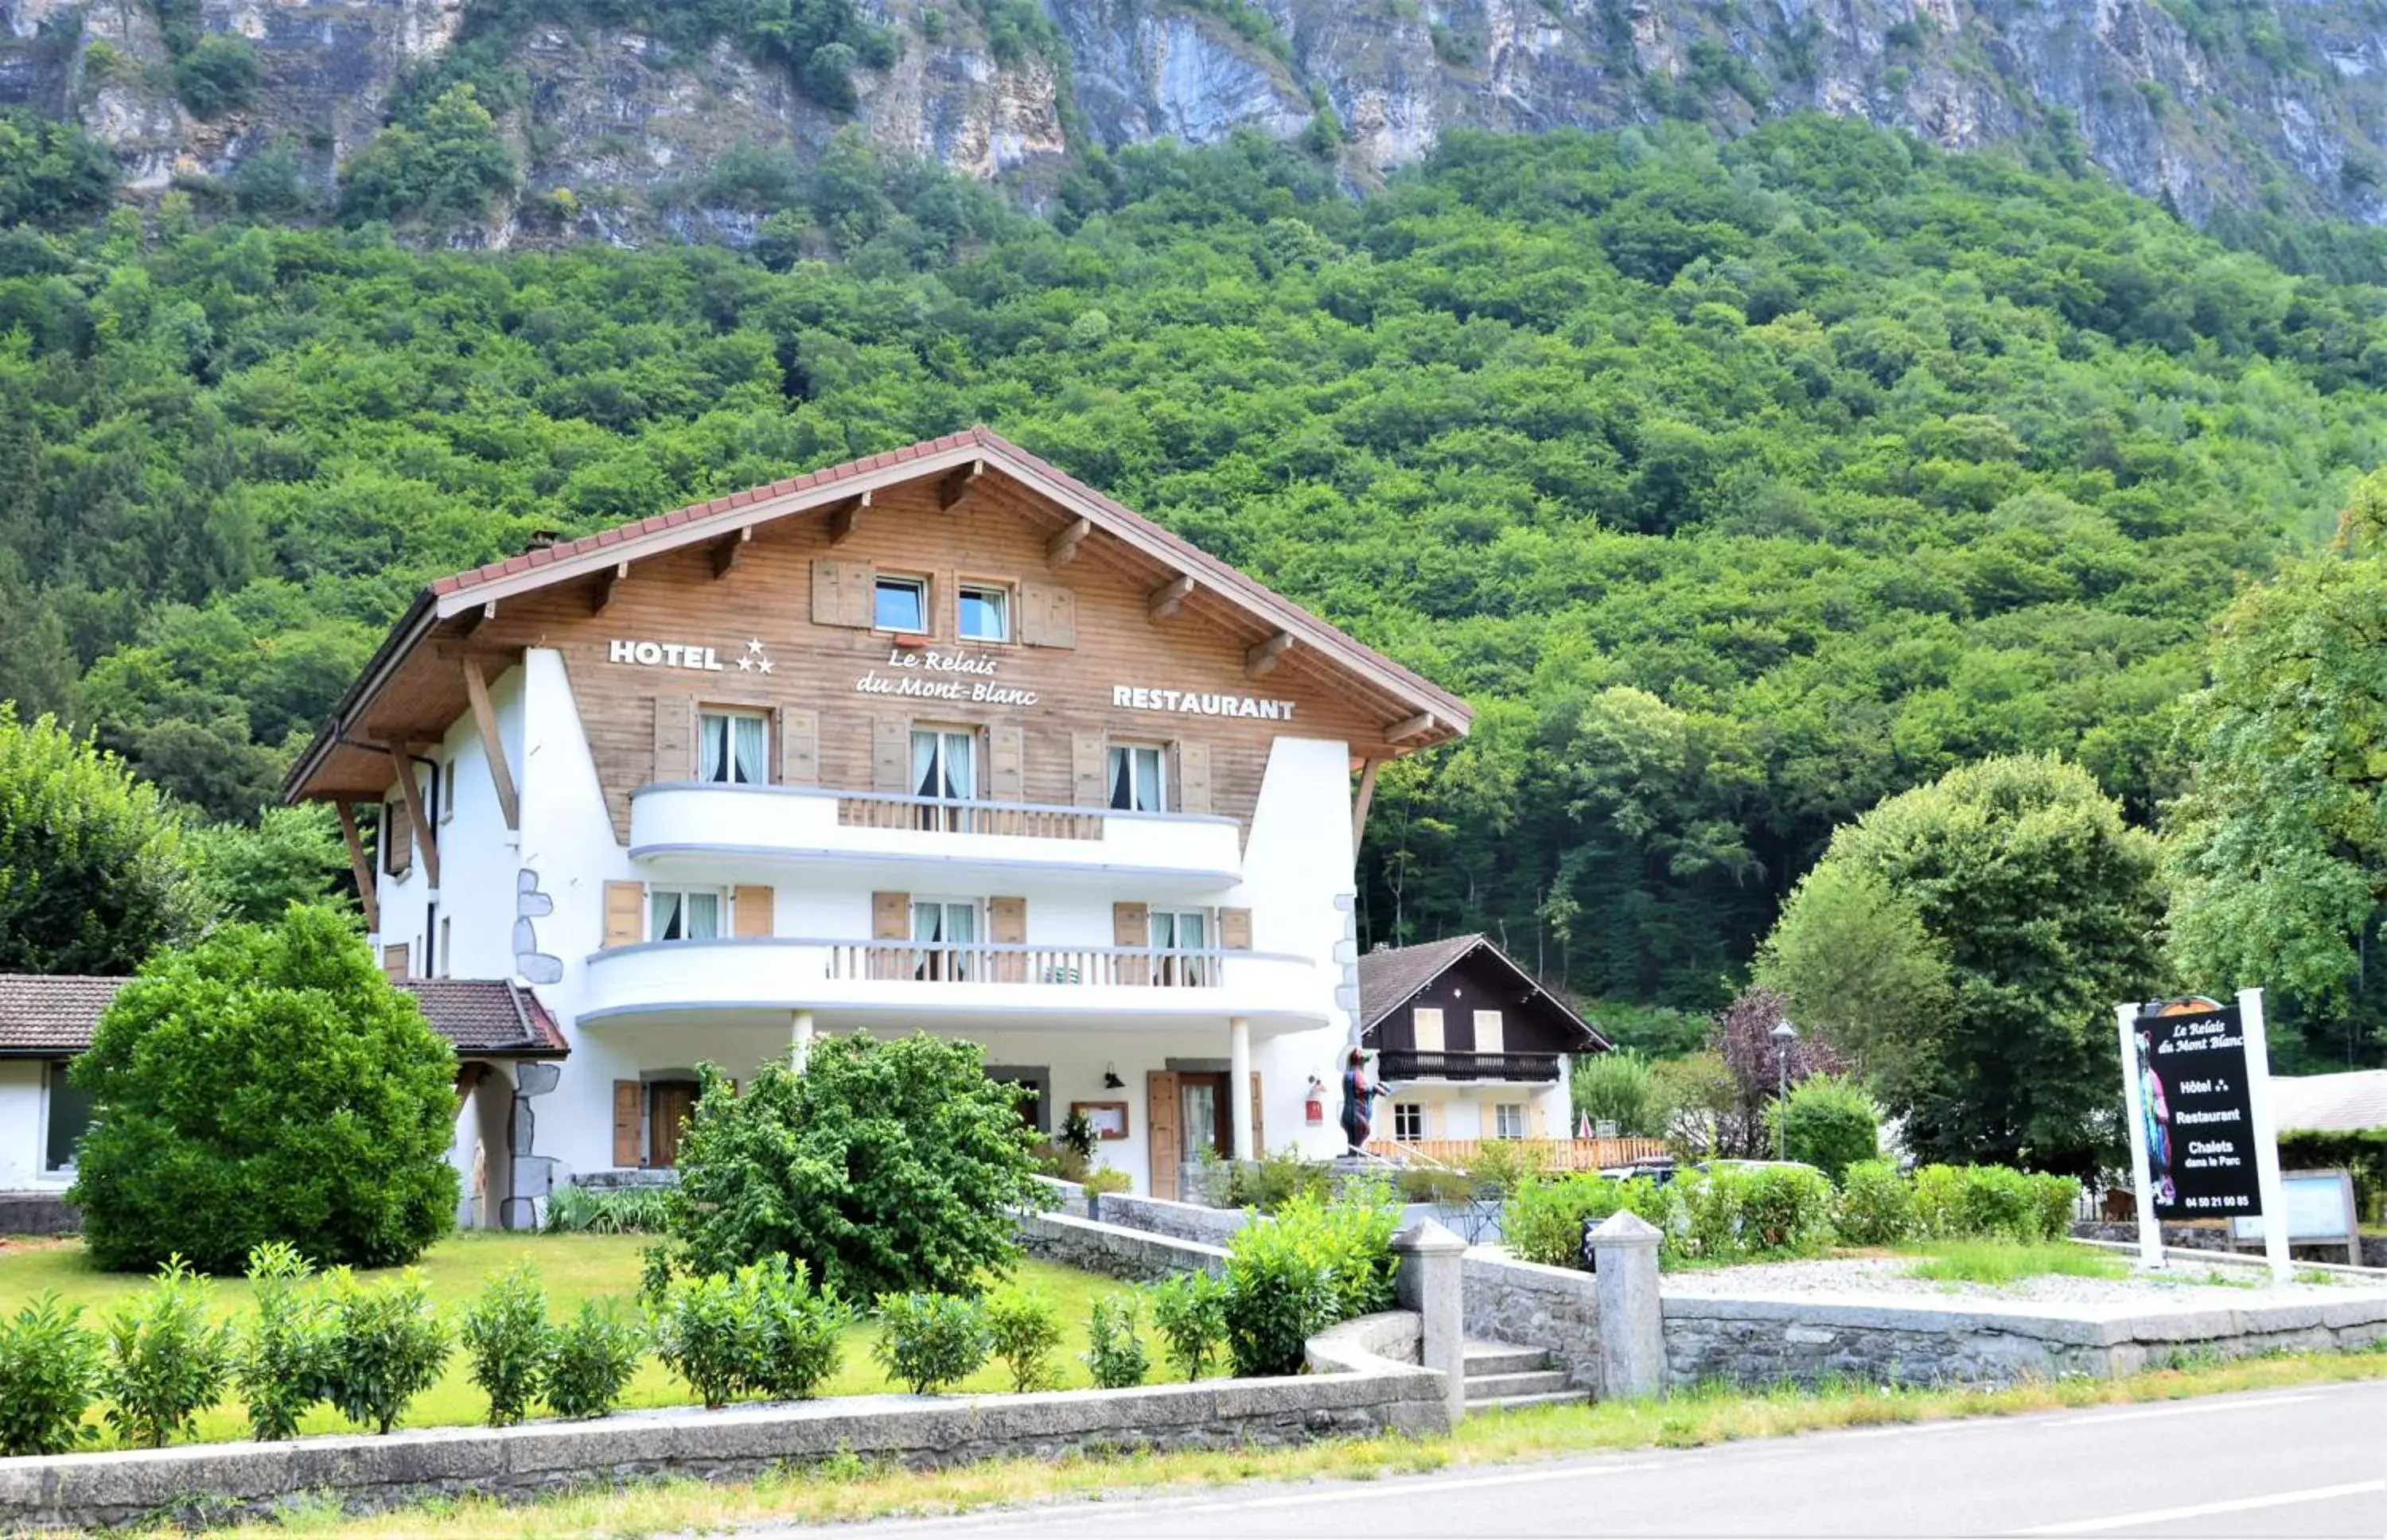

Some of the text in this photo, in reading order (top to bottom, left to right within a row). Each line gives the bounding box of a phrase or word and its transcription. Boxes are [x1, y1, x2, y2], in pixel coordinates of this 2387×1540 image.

[609, 639, 723, 671] HOTEL
[888, 648, 997, 676] Le Relais
[855, 670, 1040, 706] du Mont-Blanc
[1112, 685, 1296, 721] RESTAURANT
[2172, 1019, 2225, 1038] Le Relais
[2158, 1033, 2244, 1054] du Mont Blanc
[2180, 1079, 2212, 1095] Hôtel
[2175, 1107, 2241, 1125] Restaurant
[2188, 1140, 2234, 1155] Chalets
[2185, 1155, 2241, 1169] dans le Parc
[2185, 1196, 2197, 1208] 04
[2198, 1196, 2210, 1208] 50
[2210, 1196, 2222, 1208] 21
